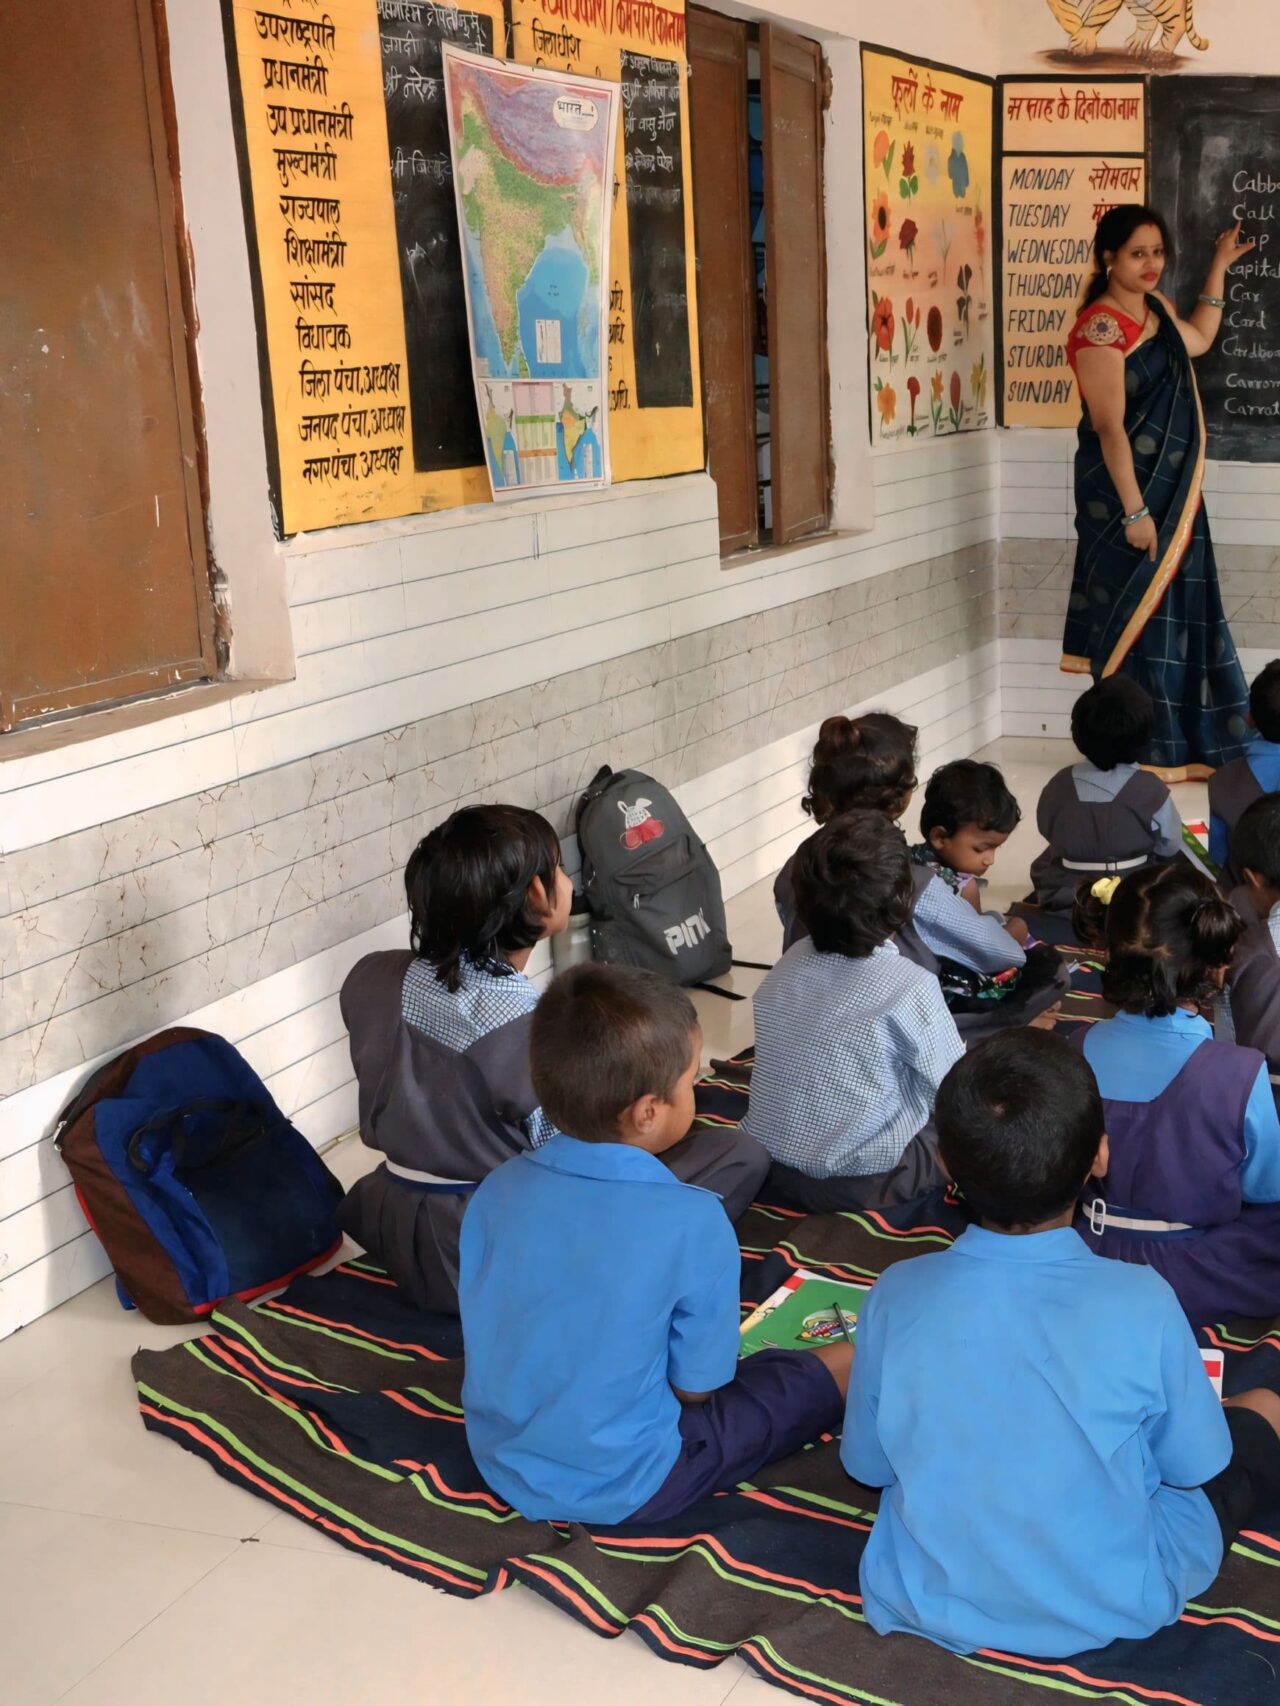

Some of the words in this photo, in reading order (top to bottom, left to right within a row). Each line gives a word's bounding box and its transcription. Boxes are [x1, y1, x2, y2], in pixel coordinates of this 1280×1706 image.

[262, 55, 329, 97] प्रधानमंत्री
[922, 72, 936, 114] के
[940, 88, 964, 123] नाम
[1117, 97, 1141, 120] नाम
[266, 104, 287, 136] उप
[288, 101, 354, 141] प्रधानमंत्री
[1009, 167, 1075, 191] MONDAY
[1088, 160, 1142, 192] सोमवार
[279, 195, 340, 229] राज्यपाल
[1008, 203, 1071, 228] TUESDAY
[1232, 202, 1275, 221] Call
[1008, 238, 1095, 264] WEDNESDAY
[290, 274, 337, 315] सांसद
[1008, 272, 1083, 298] THURSDAY
[1230, 283, 1260, 302] Car
[295, 316, 351, 351] विधायक
[1008, 309, 1066, 333] FRIDAY
[1229, 310, 1266, 330] Card
[299, 359, 332, 402] जिला
[1007, 379, 1073, 404] SUNDAY
[298, 413, 339, 444] जनपद
[663, 907, 711, 955] PINK
